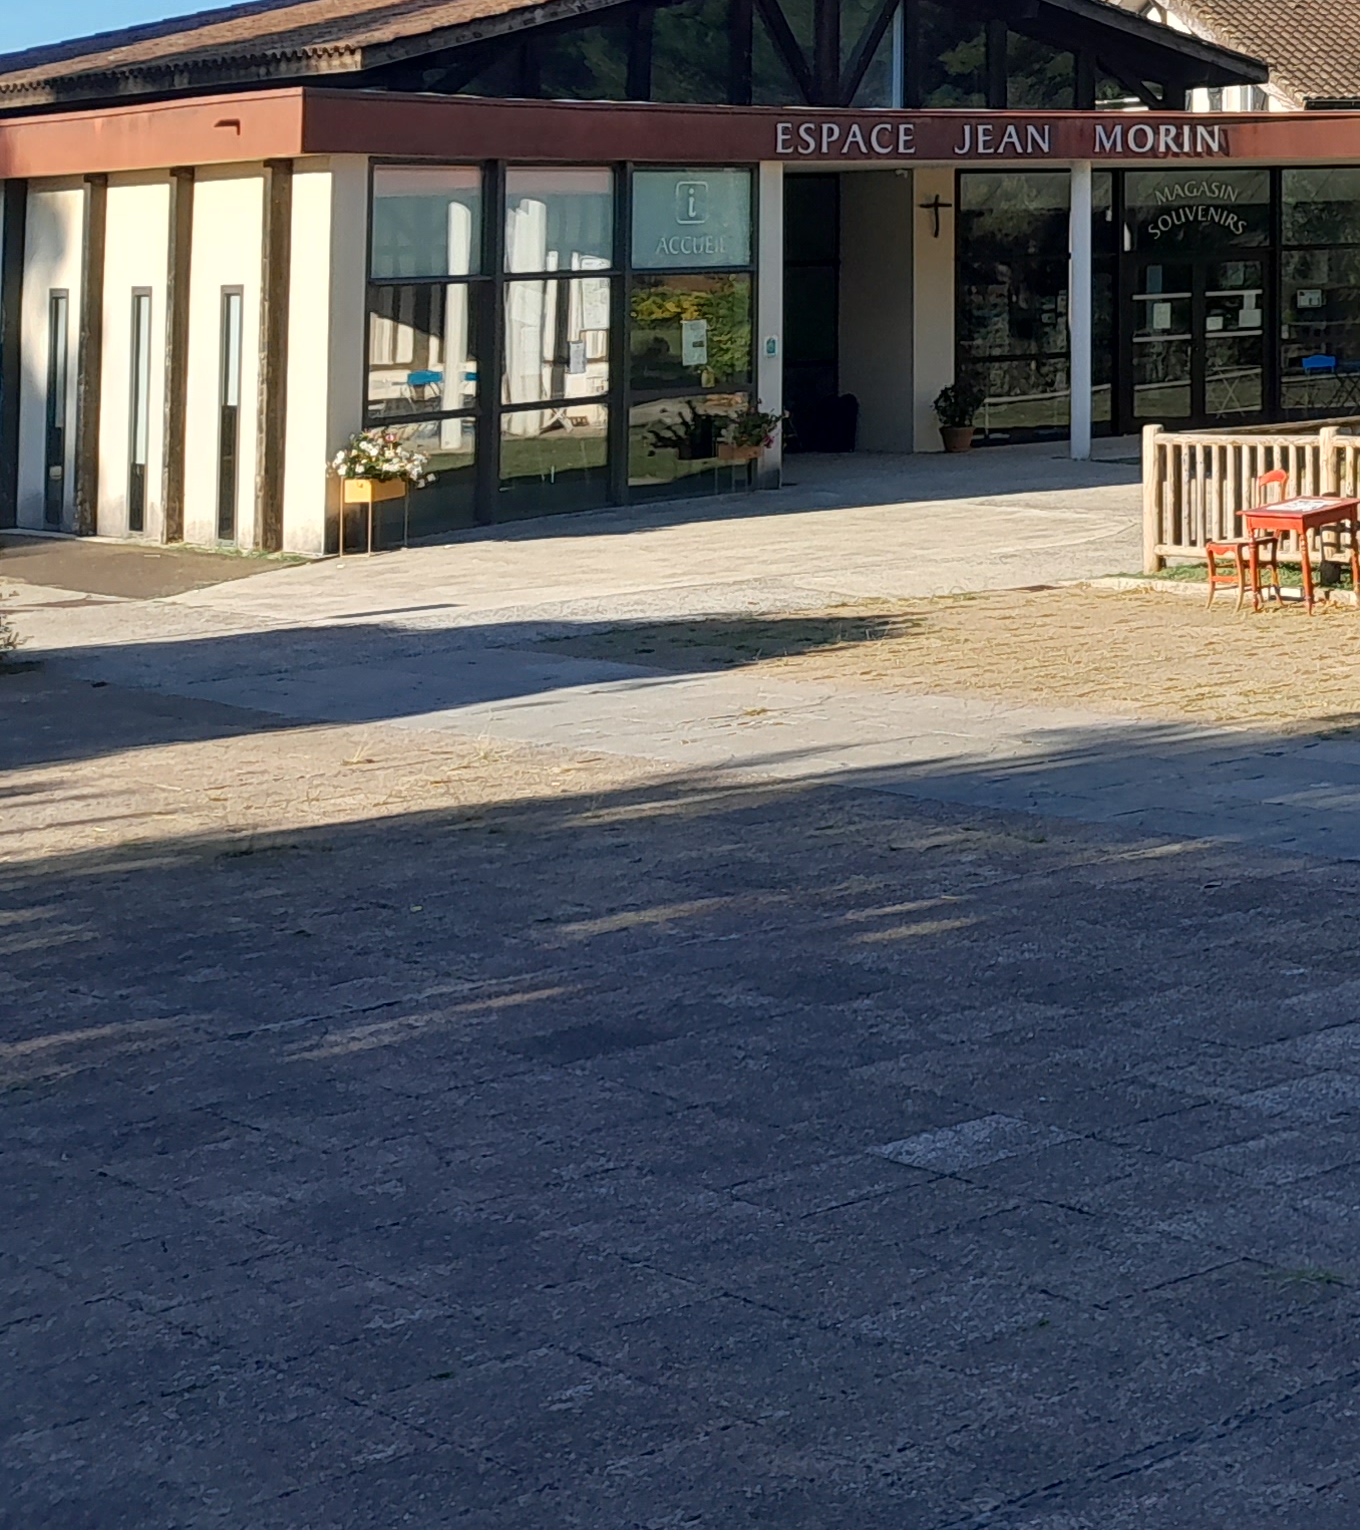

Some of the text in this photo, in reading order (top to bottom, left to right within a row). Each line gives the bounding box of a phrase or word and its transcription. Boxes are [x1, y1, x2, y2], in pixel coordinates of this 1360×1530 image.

[775, 122, 1220, 154] ESPACE JEAN MORIN
[1154, 180, 1239, 205] MAGASIN
[1148, 205, 1247, 240] SOUVENIRS
[655, 235, 727, 255] ACCUEIL
